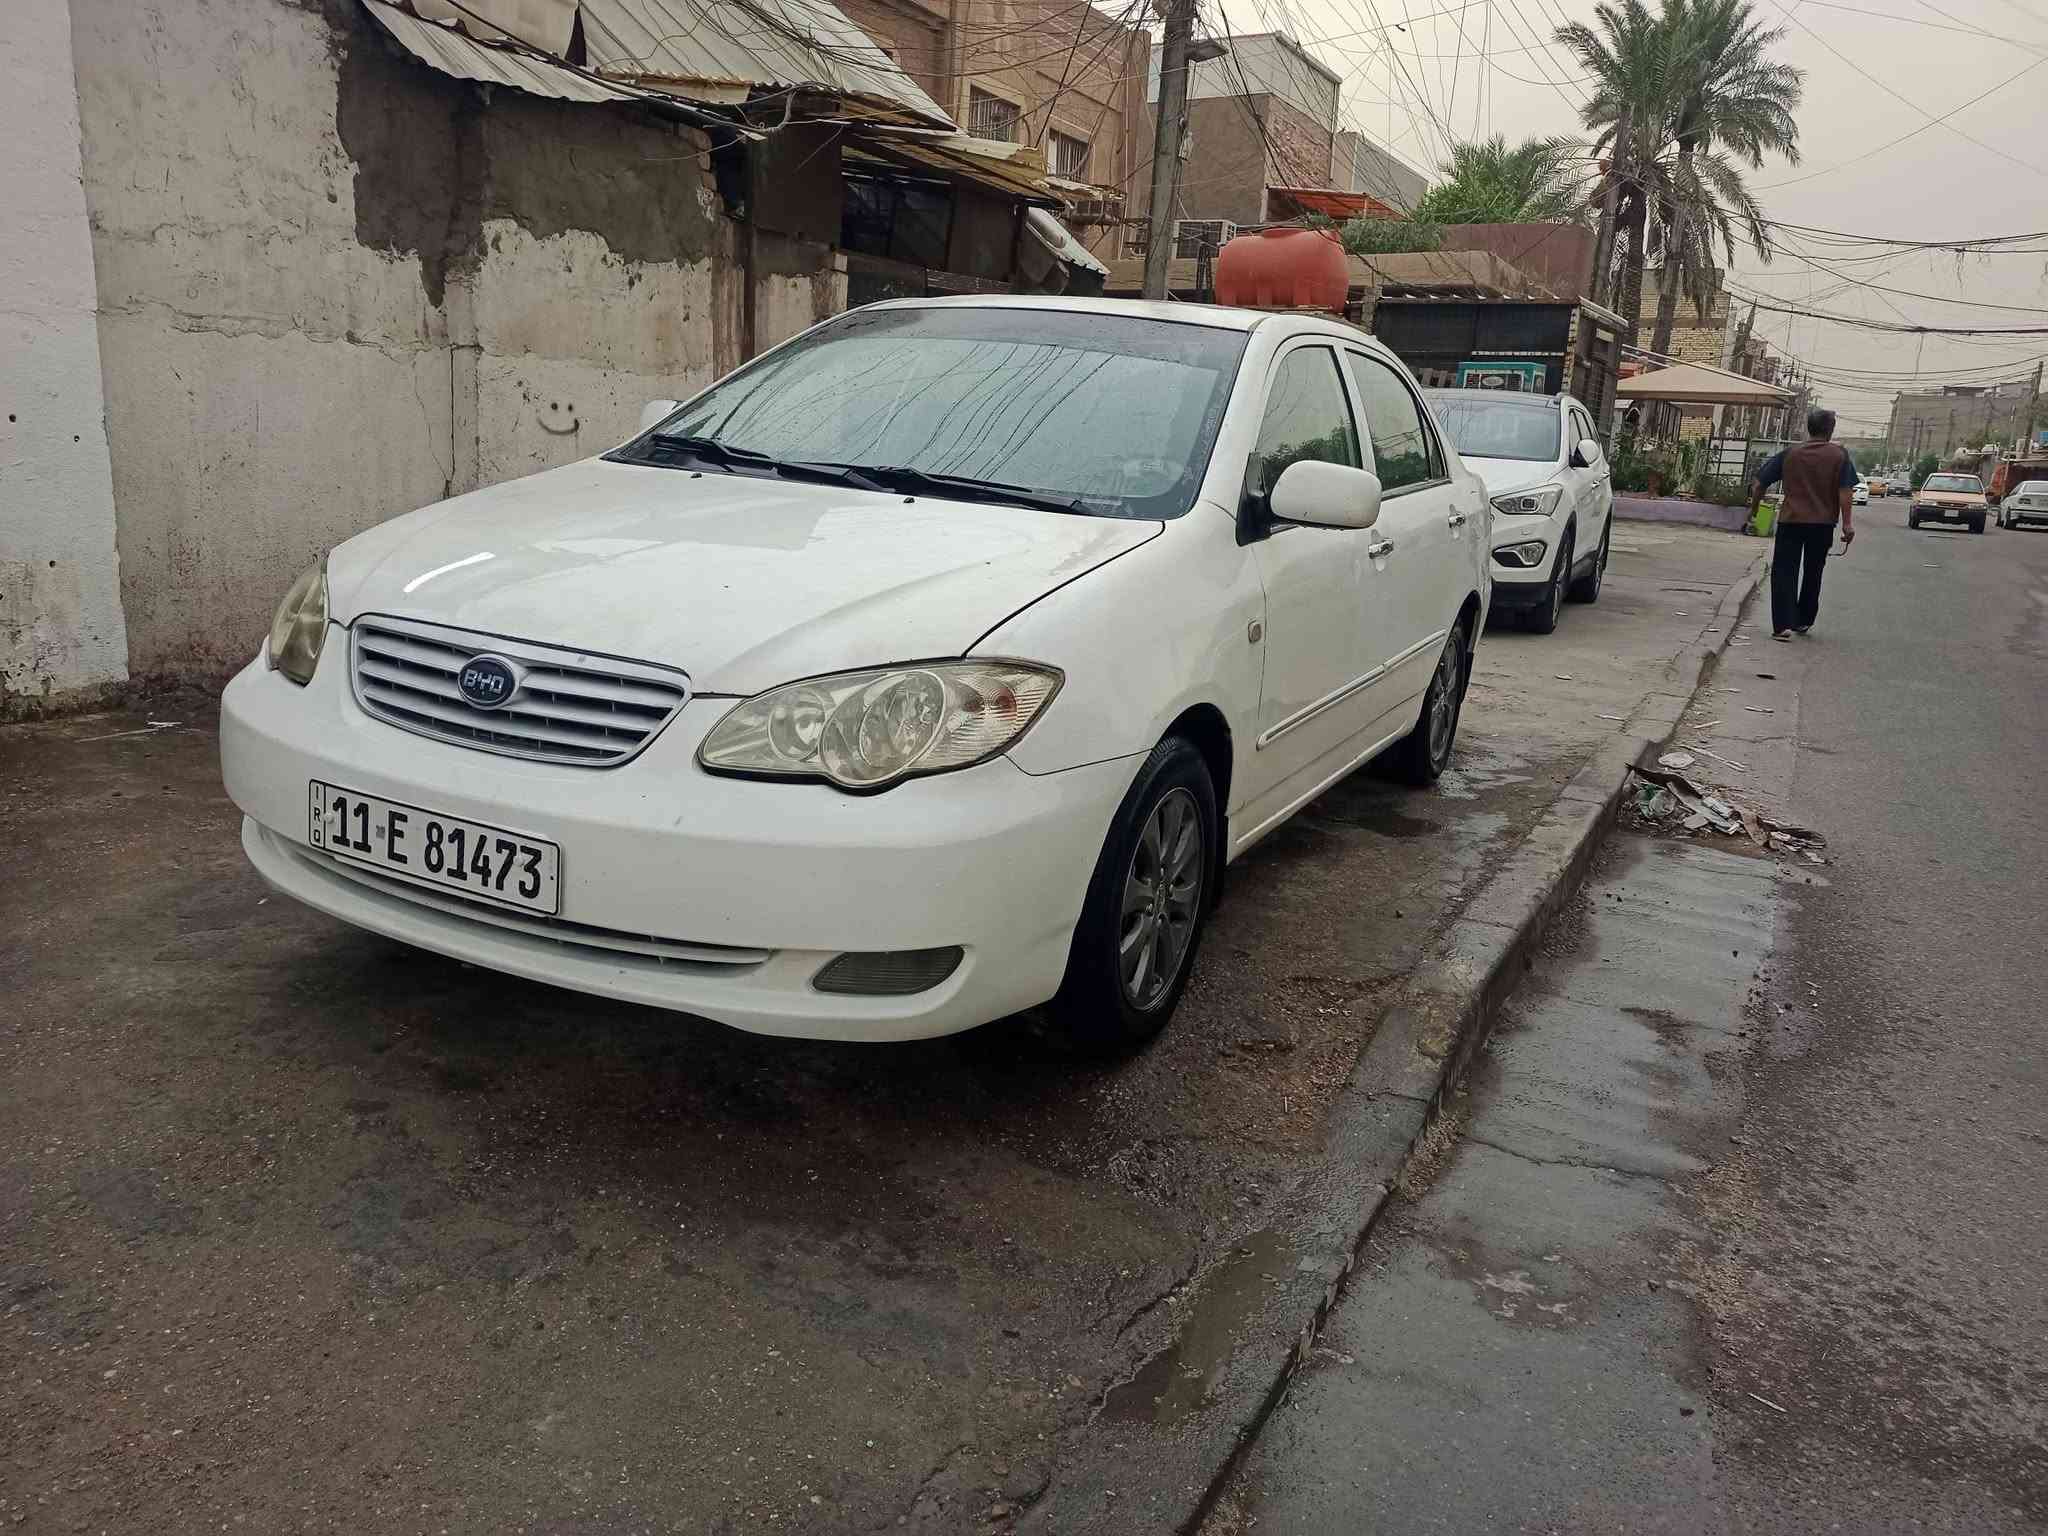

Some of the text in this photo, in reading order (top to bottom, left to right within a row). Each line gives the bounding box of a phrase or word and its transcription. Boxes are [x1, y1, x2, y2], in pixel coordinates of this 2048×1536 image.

[463, 669, 505, 694] BYD
[332, 797, 542, 898] 11 E 81473
